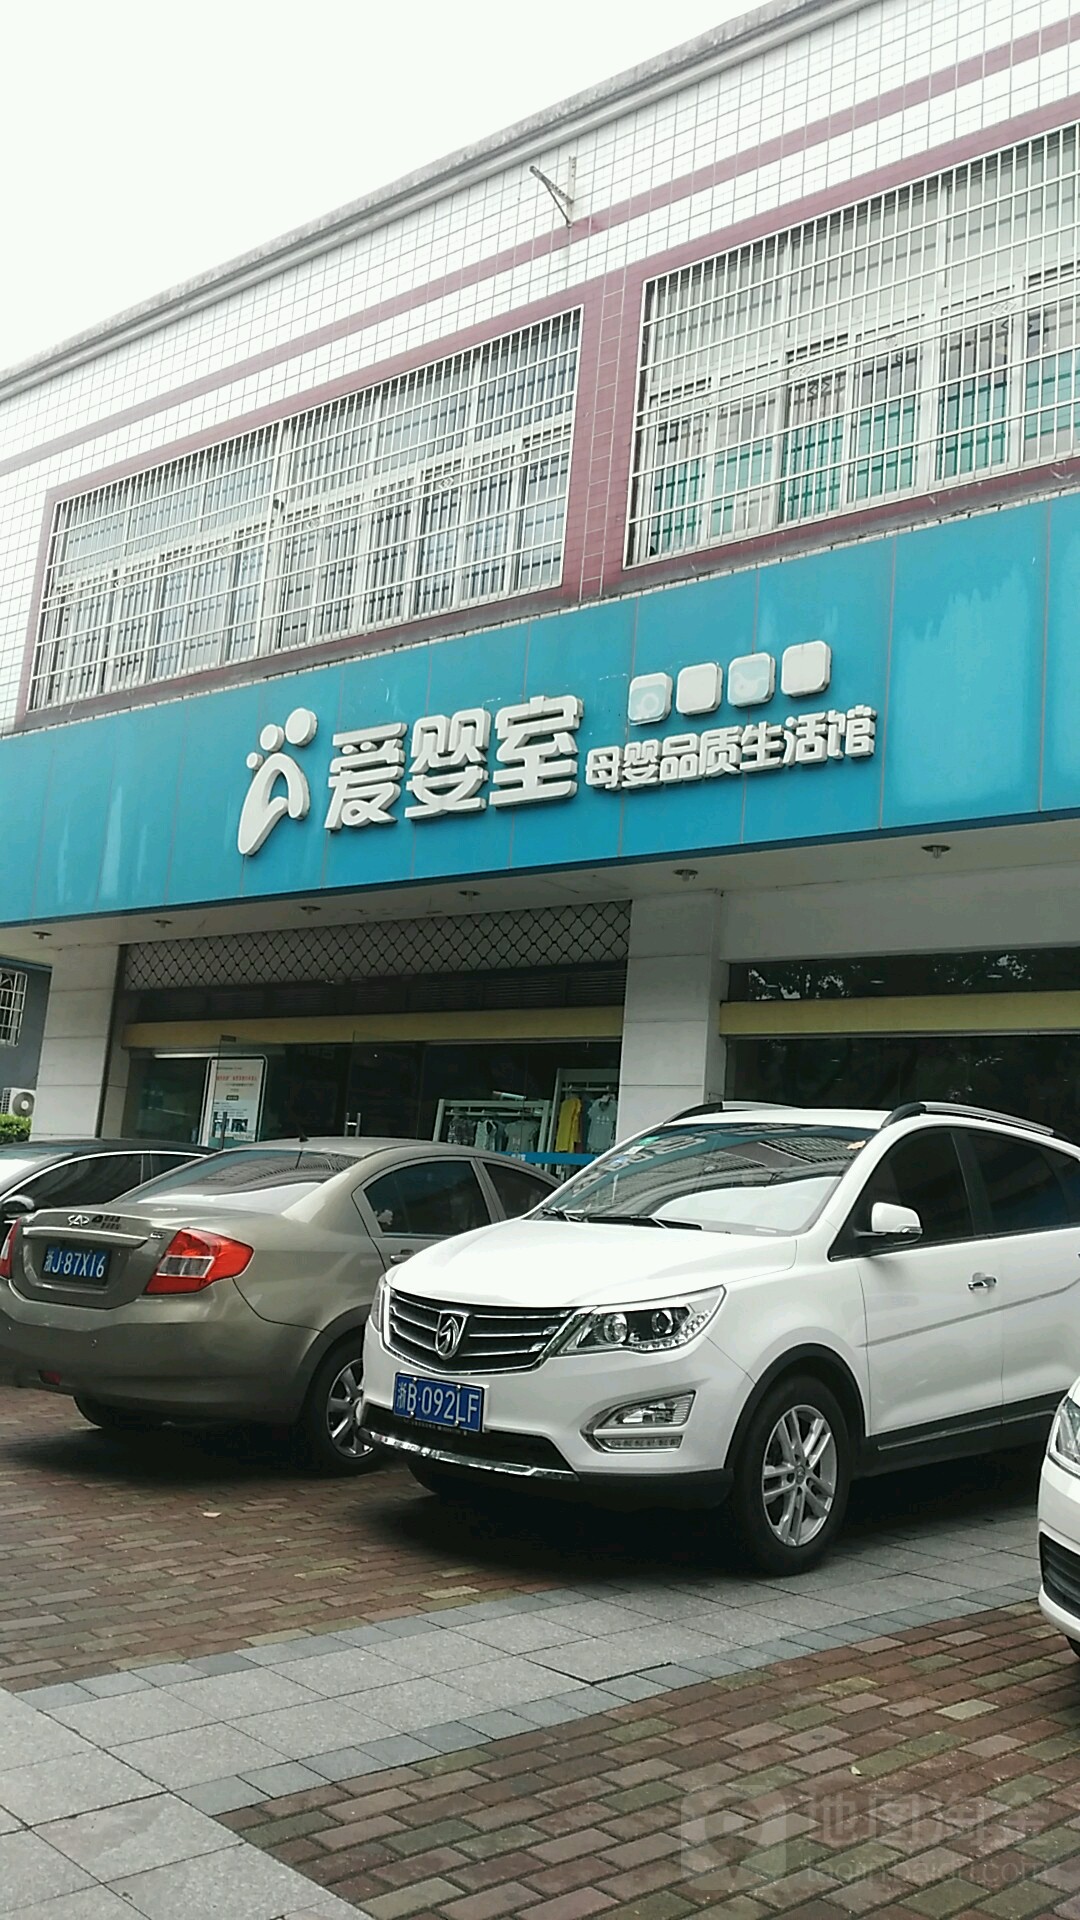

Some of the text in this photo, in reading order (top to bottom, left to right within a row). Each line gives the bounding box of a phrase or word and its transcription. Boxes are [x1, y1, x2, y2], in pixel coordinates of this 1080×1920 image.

[324, 694, 584, 831] 爱婴室
[585, 705, 877, 790] 母婴品质生活馆
